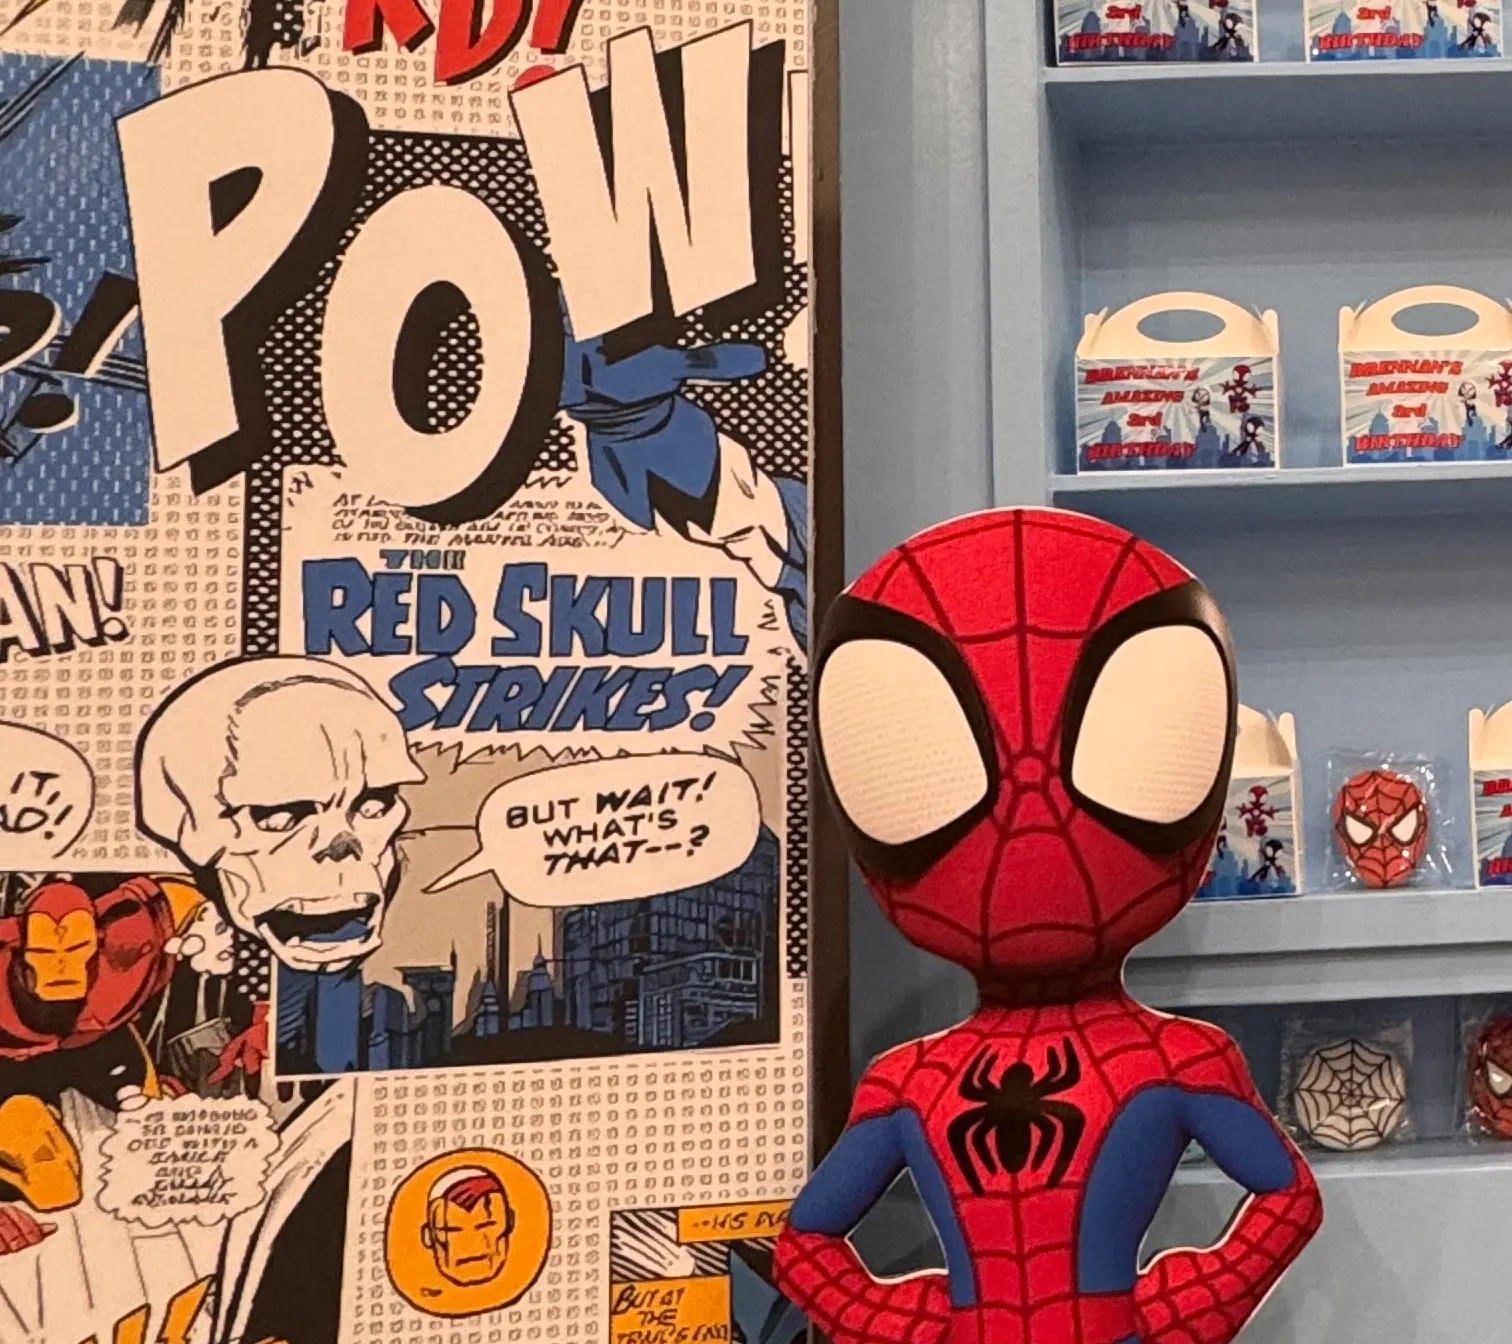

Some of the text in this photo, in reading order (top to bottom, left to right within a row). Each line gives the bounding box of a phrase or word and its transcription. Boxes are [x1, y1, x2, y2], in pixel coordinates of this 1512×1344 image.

[379, 548, 467, 570] THE
[302, 557, 751, 658] RED SKULL
[386, 664, 752, 733] STRIKES!
[506, 771, 718, 829] BUT WAIT!
[543, 808, 679, 848] WHAT'S
